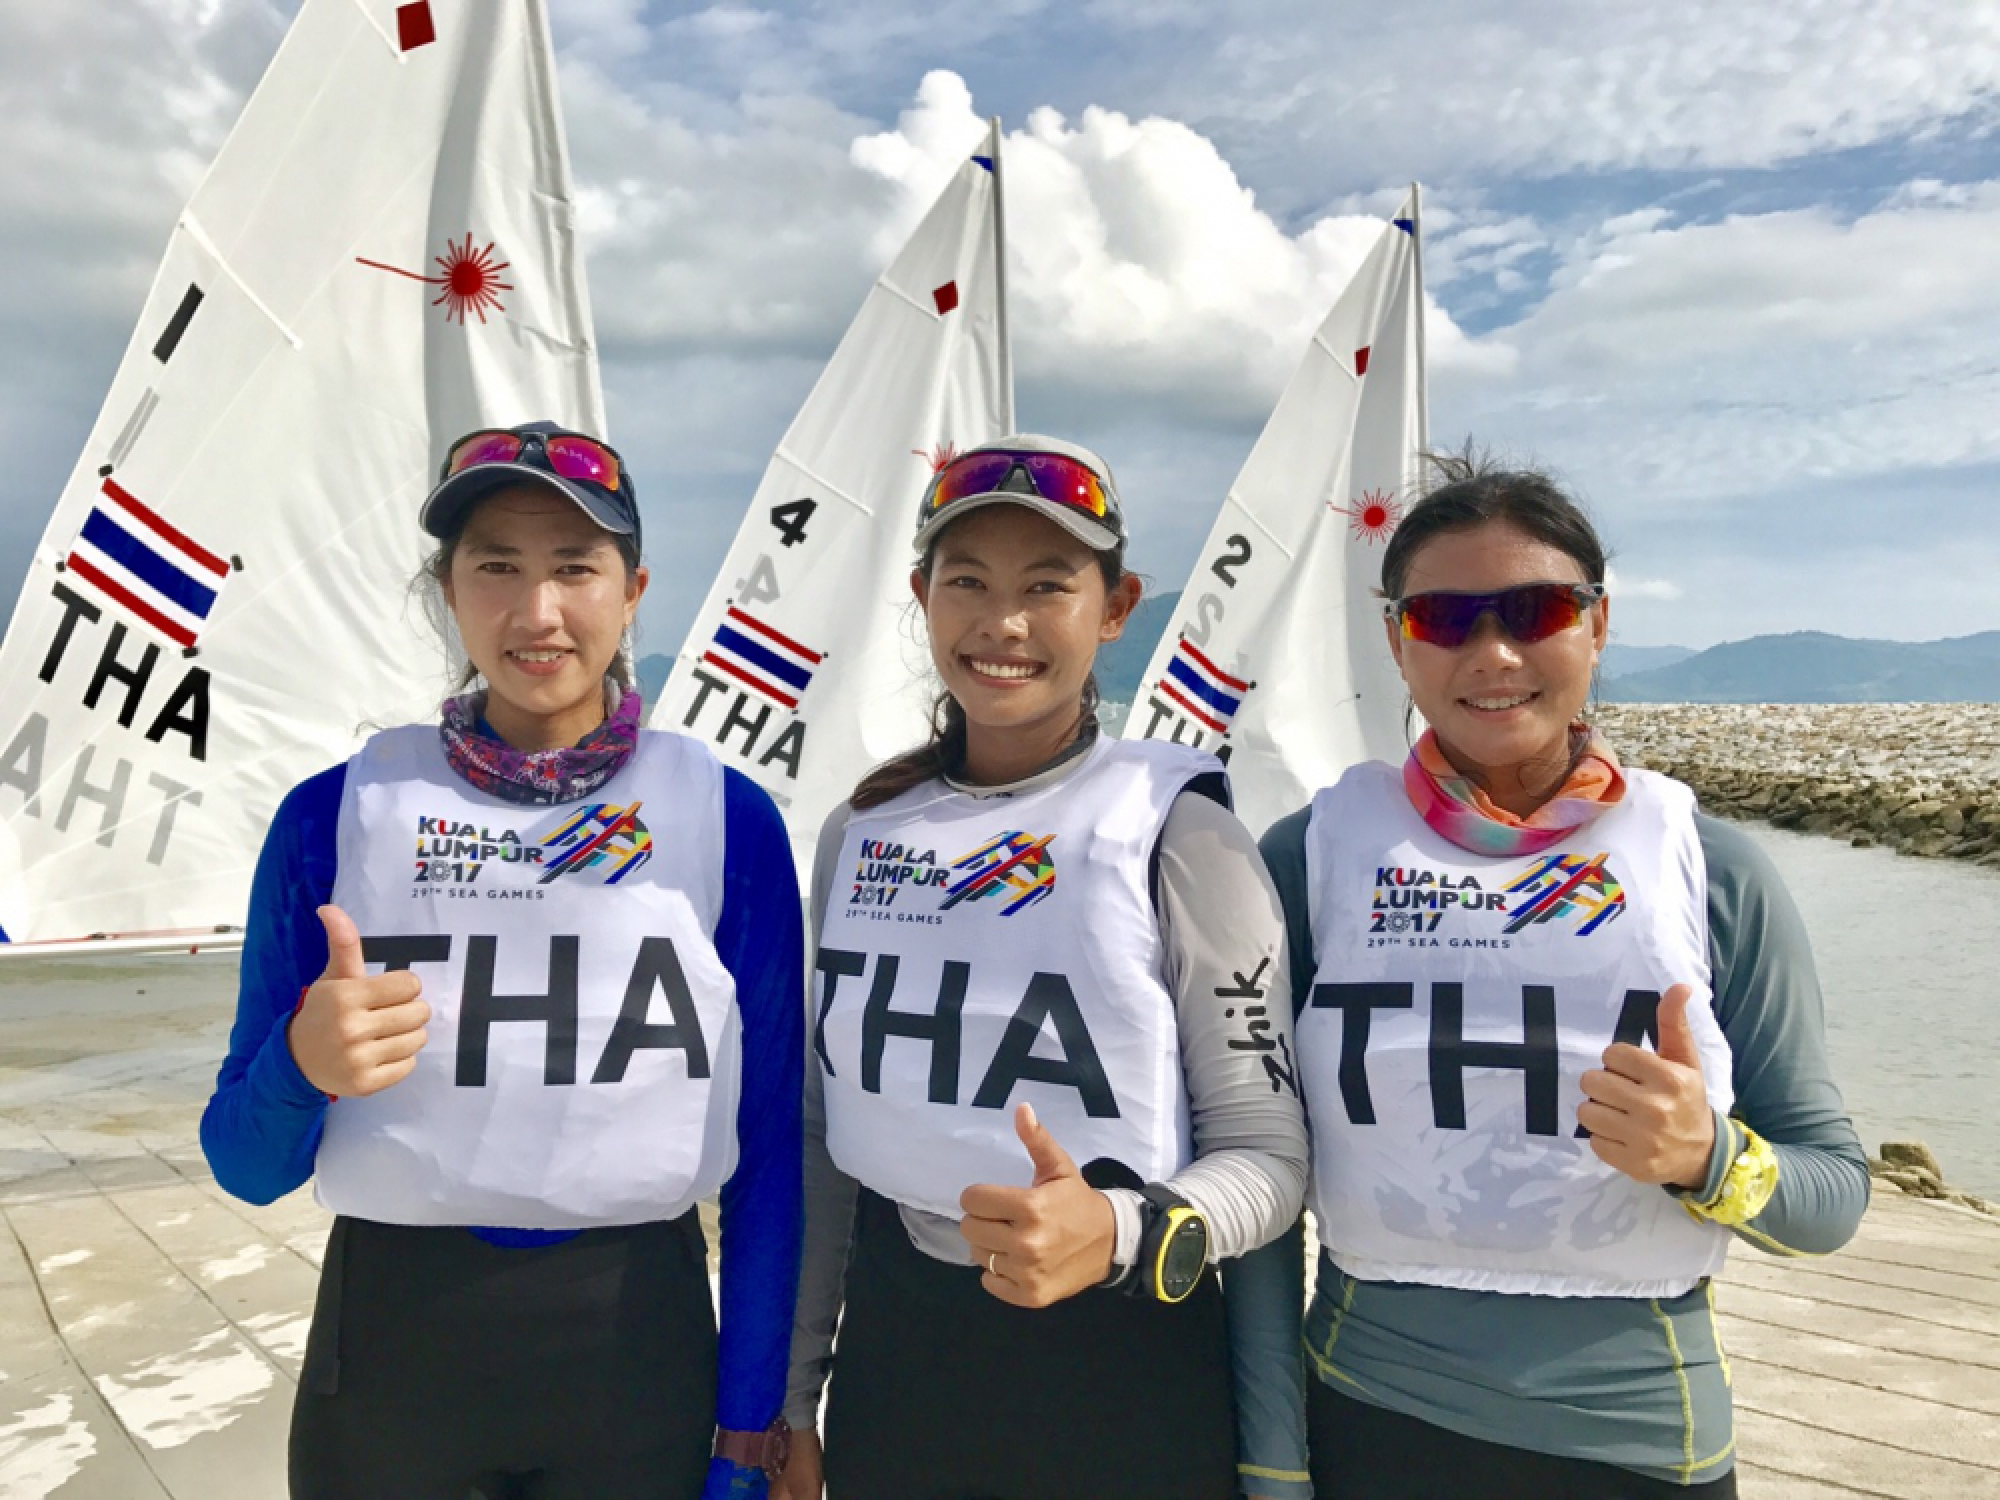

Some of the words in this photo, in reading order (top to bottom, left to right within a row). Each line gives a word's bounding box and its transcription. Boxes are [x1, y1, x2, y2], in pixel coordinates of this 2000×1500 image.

[769, 497, 818, 548] 4
[1211, 533, 1252, 589] 2
[38, 580, 211, 763] THA
[682, 667, 806, 780] THA
[417, 815, 522, 845] KUALA
[416, 837, 544, 864] LUMPUR
[861, 838, 937, 867] KUALA
[413, 860, 483, 882] 2017
[855, 862, 950, 888] LUMPUR
[1375, 867, 1483, 891] KUALA
[447, 888, 479, 899] SEA
[486, 889, 545, 899] GAMES
[849, 883, 899, 906] 2017
[1372, 889, 1509, 911] LUMPUR
[869, 910, 891, 921] SEA
[897, 911, 943, 925] GAMES
[1368, 911, 1443, 934] 2017
[1408, 937, 1440, 948] SEA
[1448, 937, 1511, 949] GAMES
[1214, 956, 1299, 1098] zhik
